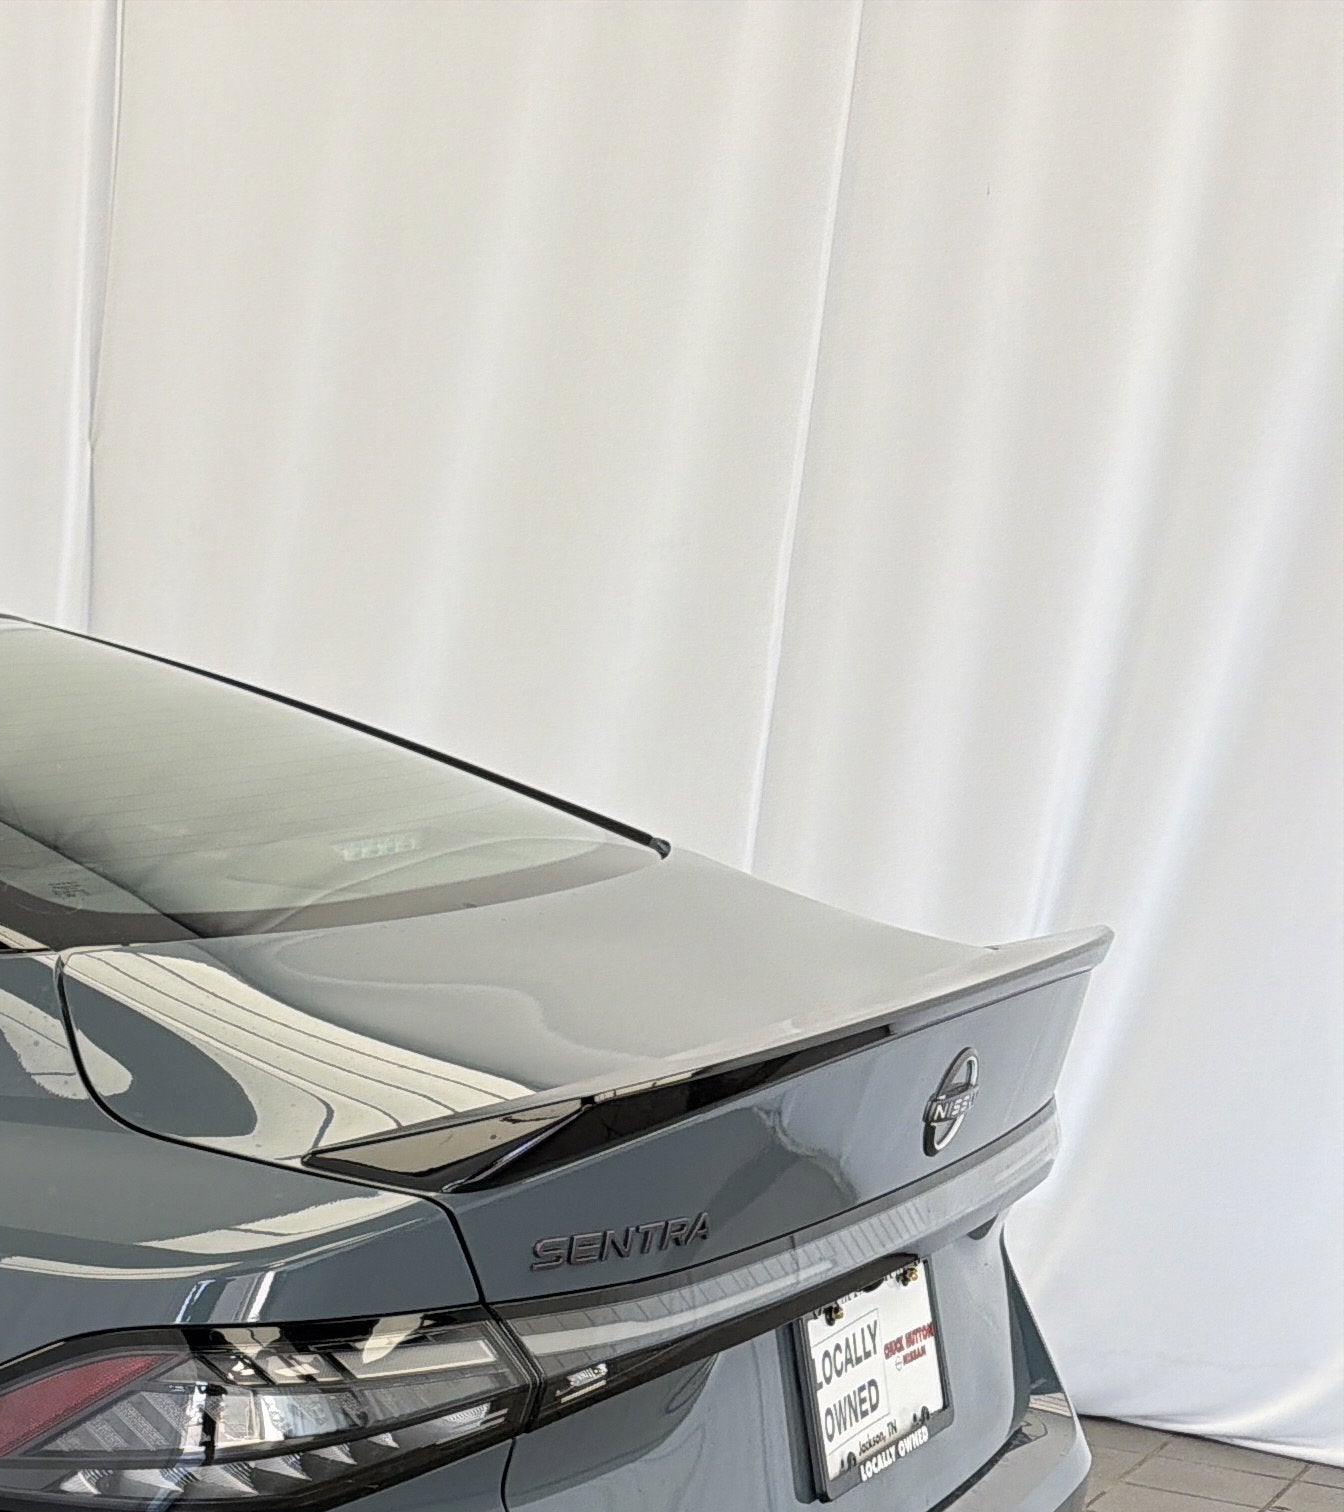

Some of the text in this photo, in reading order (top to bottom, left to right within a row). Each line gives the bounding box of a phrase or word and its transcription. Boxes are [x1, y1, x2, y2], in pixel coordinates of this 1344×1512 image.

[530, 1211, 712, 1271] SENTRA
[812, 1319, 878, 1392] LOCALLY
[824, 1378, 880, 1443] OWNED
[886, 1418, 897, 1437] TN
[860, 1425, 929, 1482] LOCALLY OWNED
